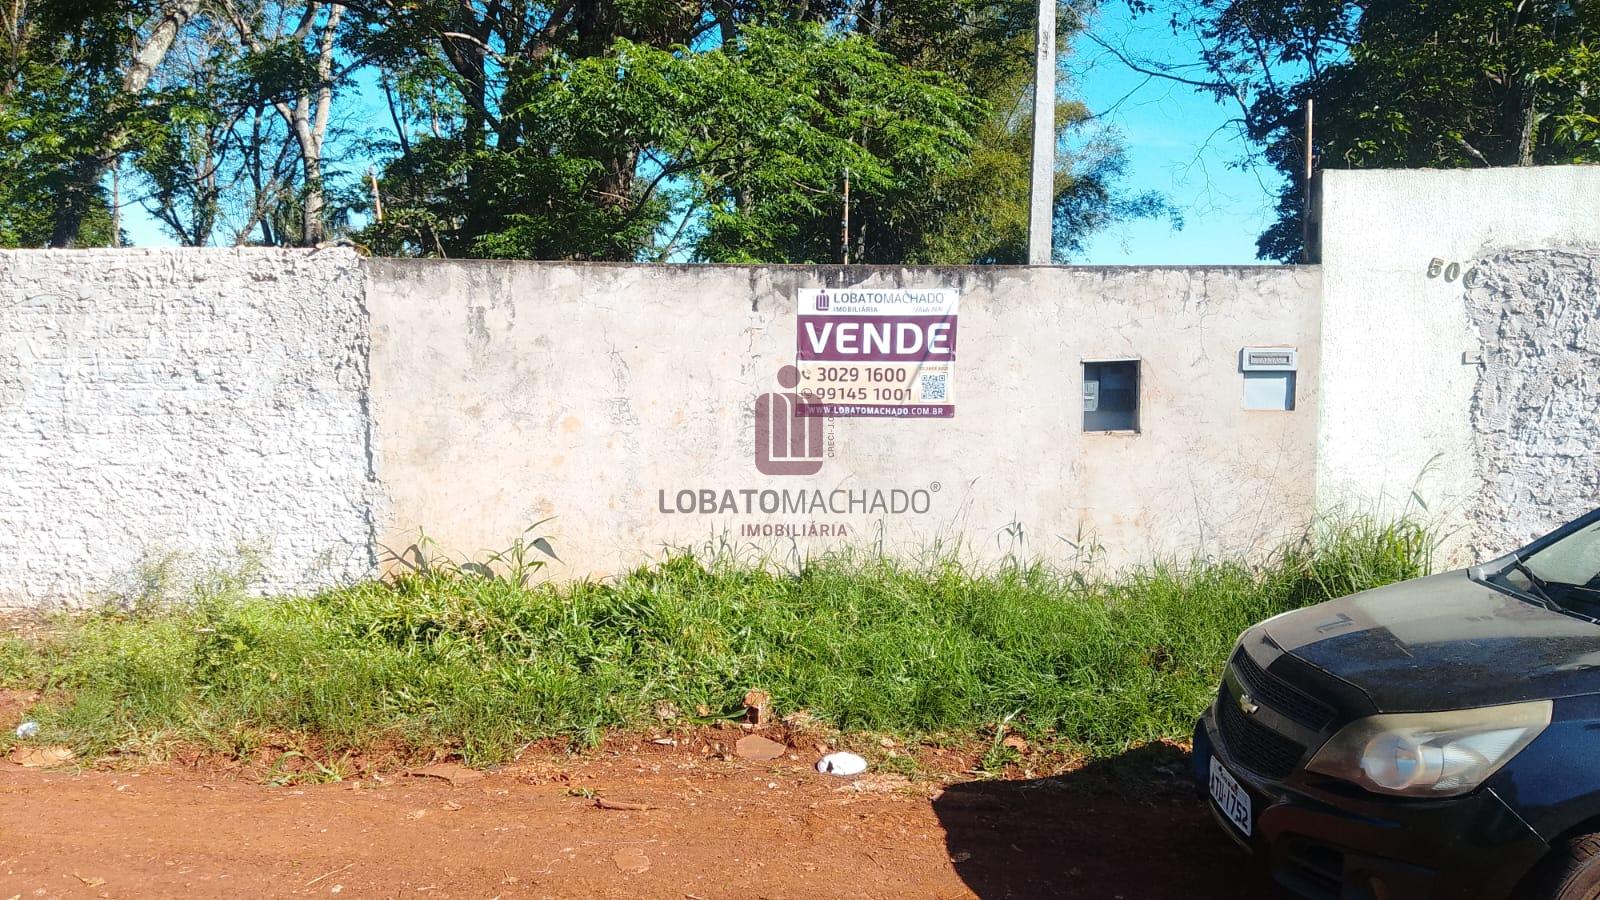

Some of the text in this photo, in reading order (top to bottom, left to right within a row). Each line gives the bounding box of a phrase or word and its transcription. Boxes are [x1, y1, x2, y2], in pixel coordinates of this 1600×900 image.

[833, 292, 944, 304] LOBATOMACHADO
[833, 305, 878, 313] IMOBILIÁRIA
[804, 322, 951, 355] VENDE
[816, 367, 906, 382] 3029 1600
[816, 388, 912, 401] 99145 1001
